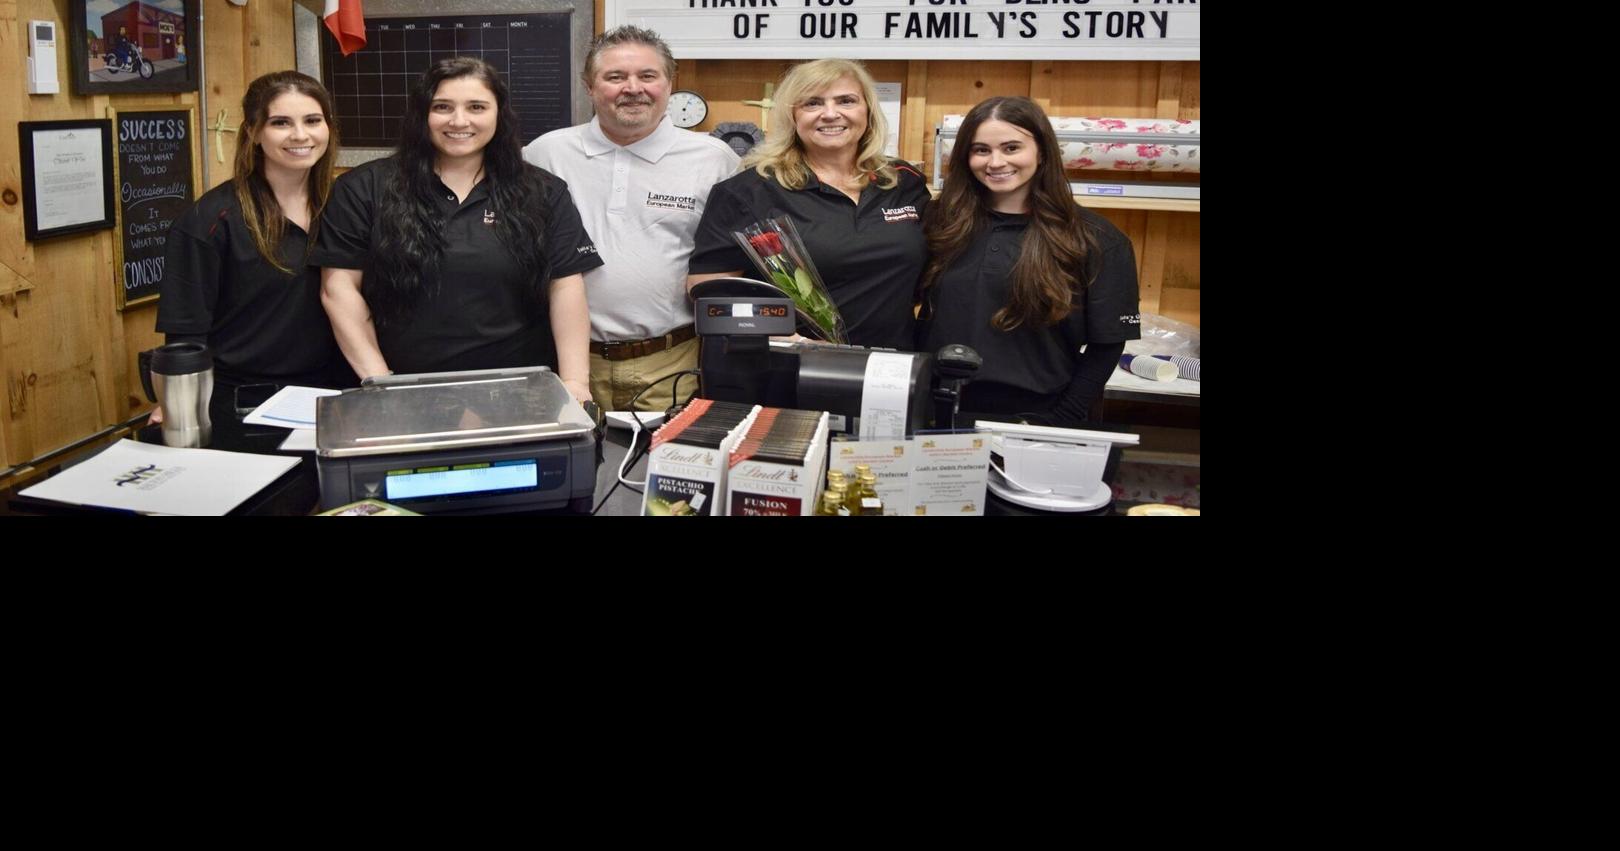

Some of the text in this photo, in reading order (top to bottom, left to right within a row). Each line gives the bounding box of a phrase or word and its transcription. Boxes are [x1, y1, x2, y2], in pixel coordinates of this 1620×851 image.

[733, 10, 1168, 39] OF OUR FAMILY'S STORY
[120, 119, 185, 141] SUCCESS
[129, 153, 174, 163] FROM WHAT
[141, 164, 167, 175] YOU DO
[121, 182, 186, 202] Occasionally
[647, 191, 696, 204] Lanzarotta
[646, 200, 675, 208] European
[129, 222, 157, 235] COMES
[130, 237, 152, 249] WHAT
[124, 256, 165, 290] CONSIST
[660, 446, 704, 463] Lindt
[737, 464, 786, 480] Lindt
[657, 478, 704, 490] PISTACHIO
[744, 497, 788, 510] FUSION
